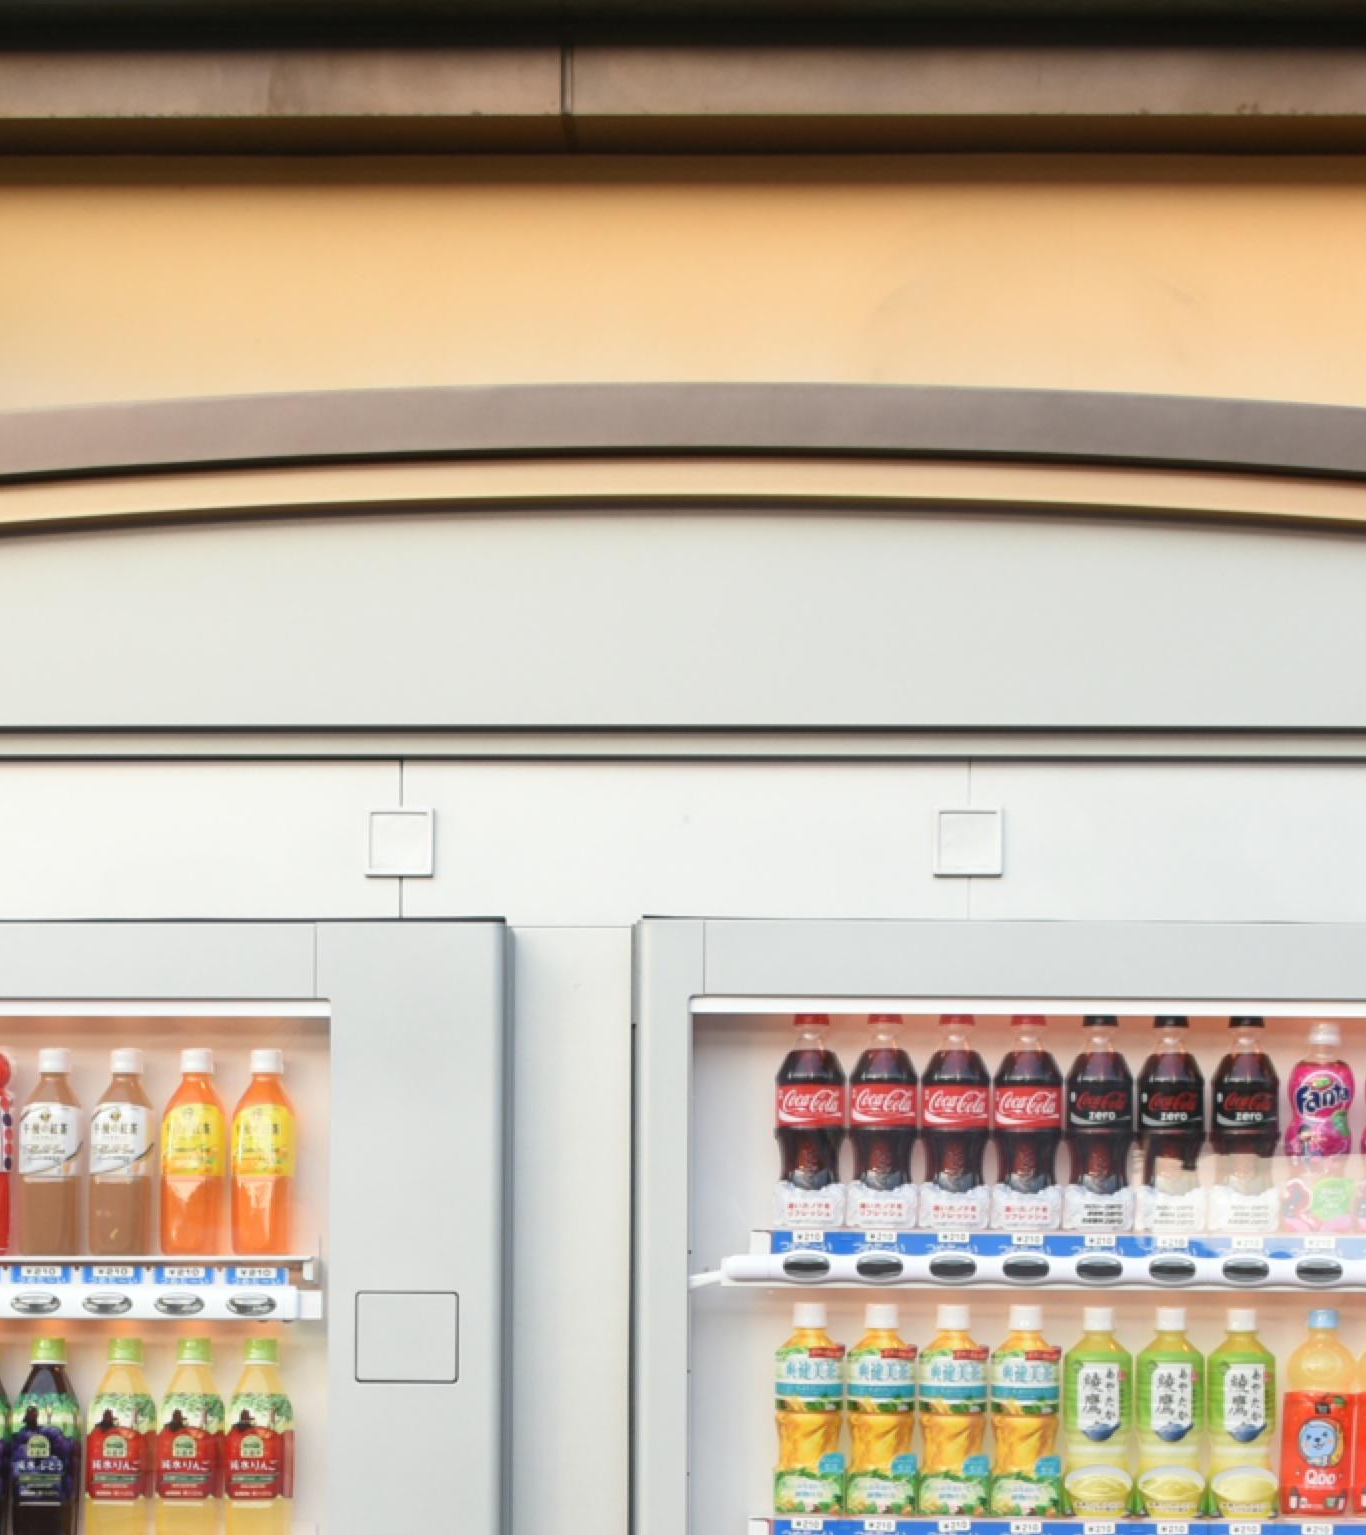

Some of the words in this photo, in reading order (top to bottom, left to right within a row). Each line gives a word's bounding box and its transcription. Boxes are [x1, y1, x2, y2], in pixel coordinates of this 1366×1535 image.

[1089, 1111, 1116, 1122] zero
[1160, 1111, 1188, 1122] zero
[1235, 1111, 1263, 1122] zero
[1305, 1467, 1337, 1486] Qoo
